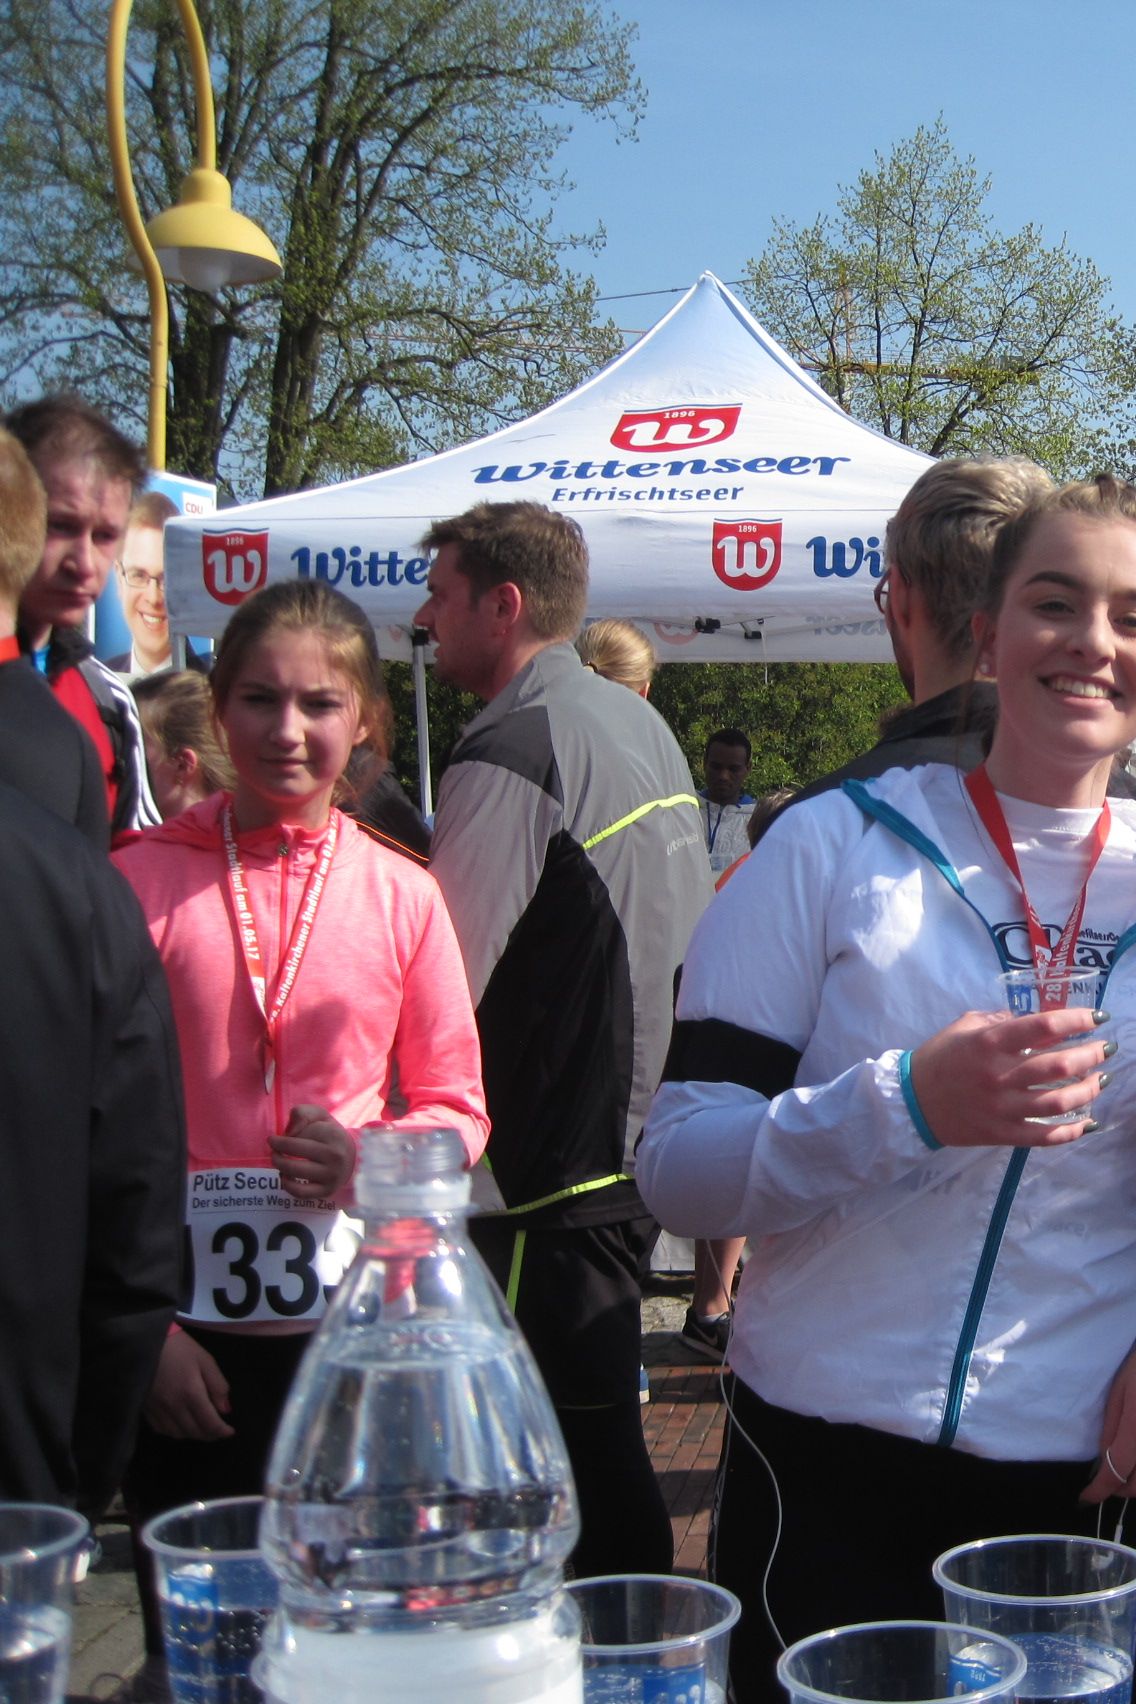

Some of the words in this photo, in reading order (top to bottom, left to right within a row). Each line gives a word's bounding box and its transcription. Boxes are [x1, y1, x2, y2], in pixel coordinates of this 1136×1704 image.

[663, 410, 696, 419] 1896
[552, 486, 744, 502] Erfrischtseer
[185, 502, 203, 515] CDU
[738, 525, 757, 533] 1896
[290, 545, 428, 587] Witte
[226, 843, 249, 892] Stadtlauf
[235, 894, 247, 911] am
[302, 875, 326, 925] Stadtlauf
[193, 1173, 230, 1192] Pütz
[234, 1171, 284, 1190] Secu
[192, 1198, 211, 1209] Der
[213, 1196, 264, 1207] sicherste
[266, 1195, 290, 1208] Weg
[293, 1200, 315, 1209] zum
[317, 1200, 336, 1210] Ziel
